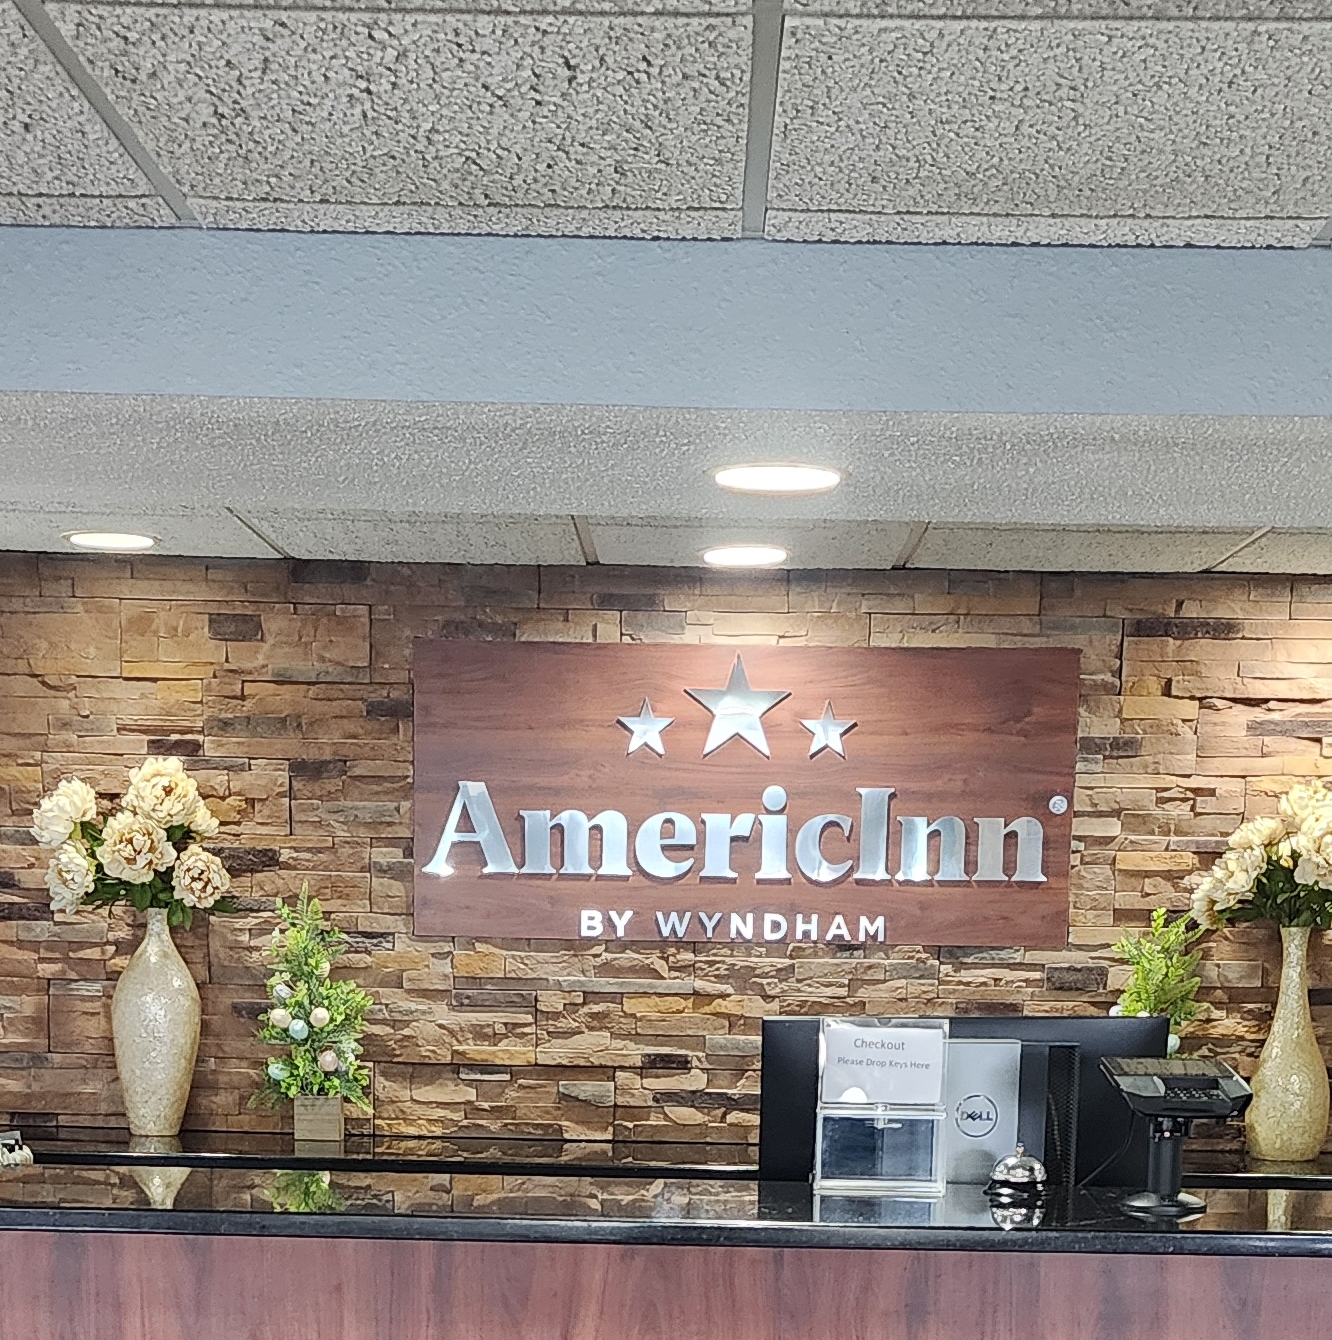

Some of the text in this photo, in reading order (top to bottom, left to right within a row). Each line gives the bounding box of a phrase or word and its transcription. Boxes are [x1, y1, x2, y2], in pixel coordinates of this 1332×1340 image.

[422, 780, 1049, 884] AmericInn
[579, 909, 886, 943] BY WYNDHAM
[853, 1038, 906, 1051] Checkout
[837, 1056, 931, 1070] Please Drop Keys Here
[960, 1110, 994, 1122] DELL
